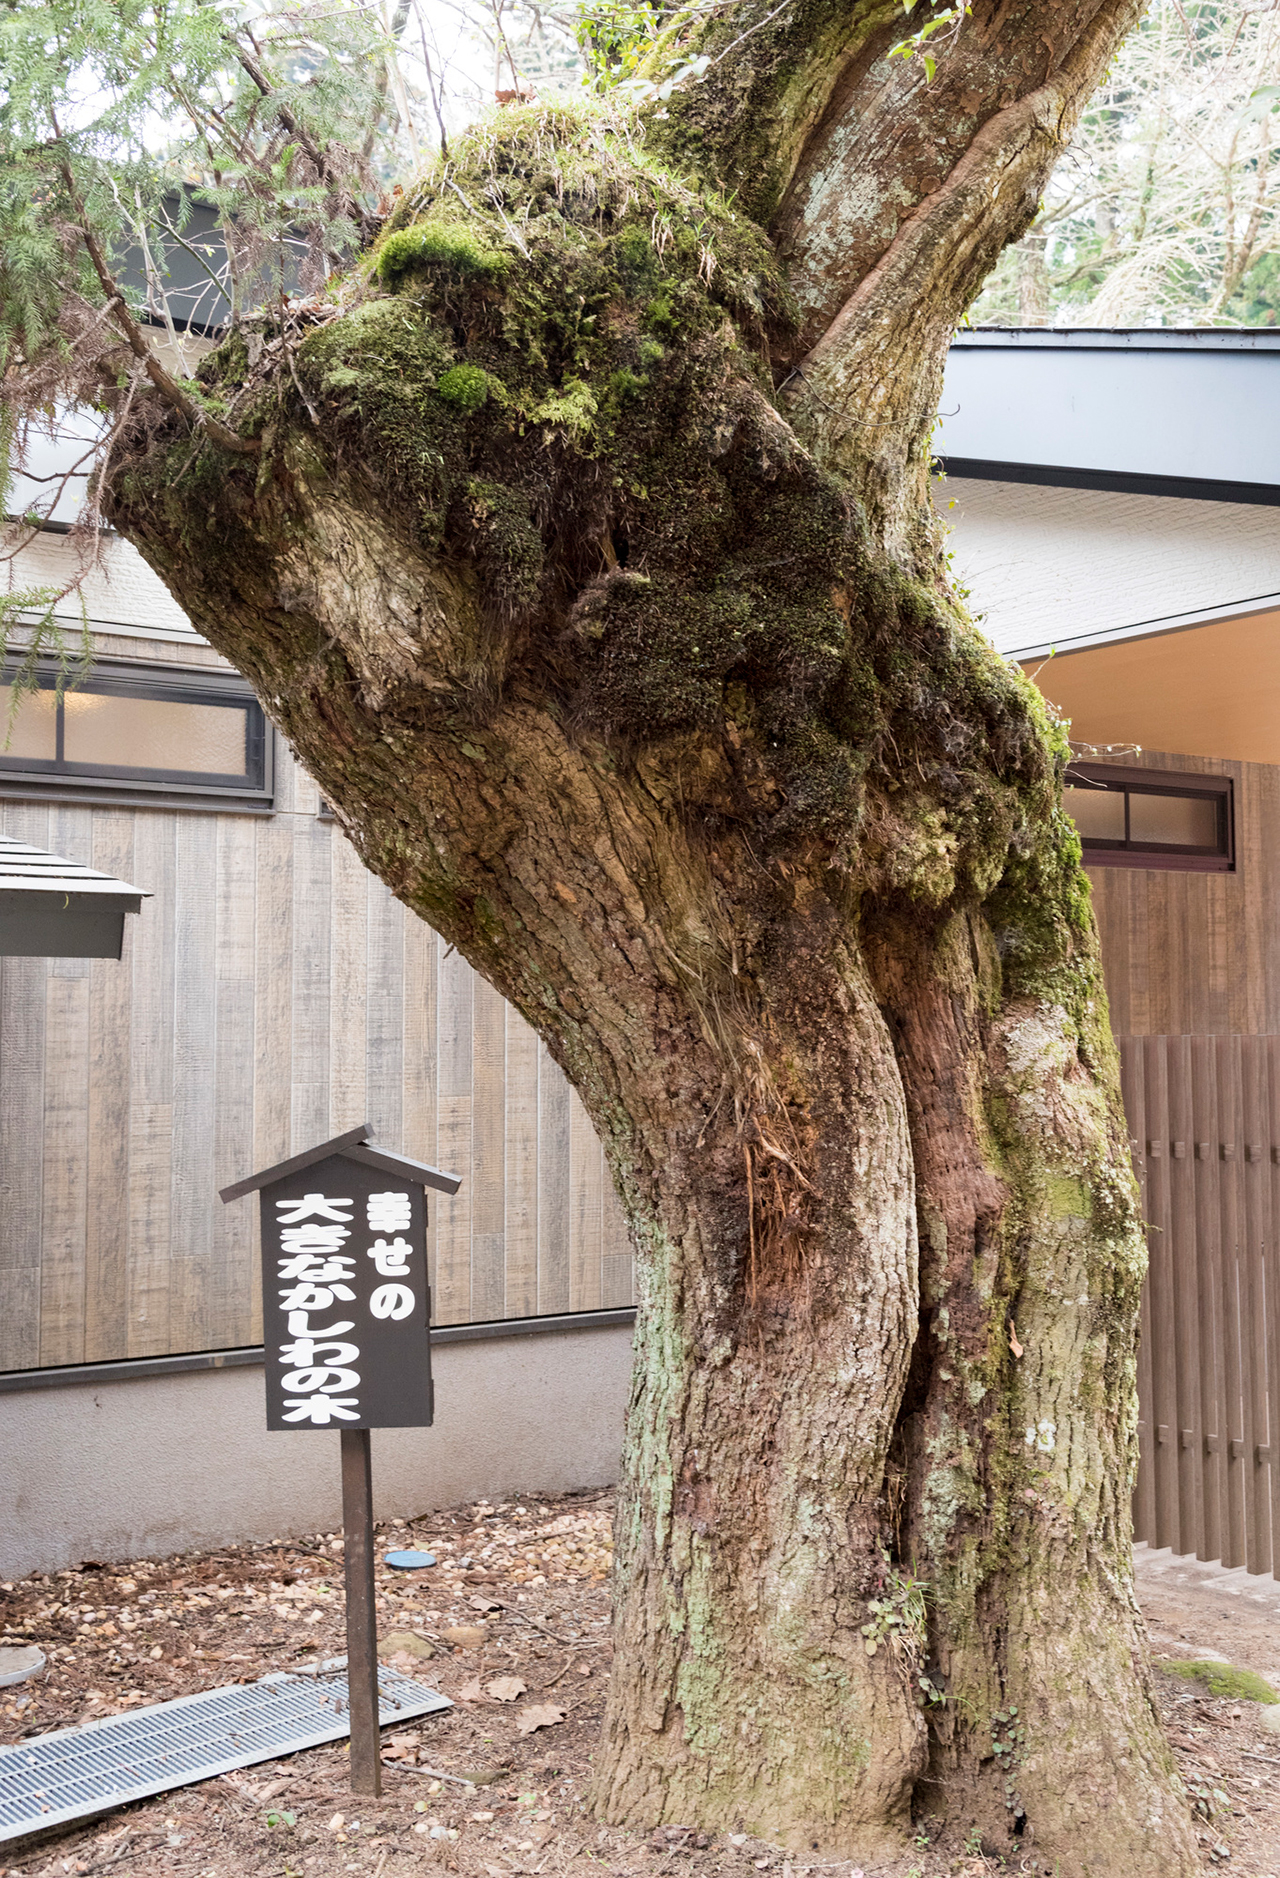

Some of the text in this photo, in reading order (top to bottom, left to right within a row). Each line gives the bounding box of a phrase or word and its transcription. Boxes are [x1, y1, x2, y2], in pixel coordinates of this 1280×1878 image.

[275, 1193, 361, 1425] 大きなかしわの木
[366, 1191, 416, 1321] 幸せの
